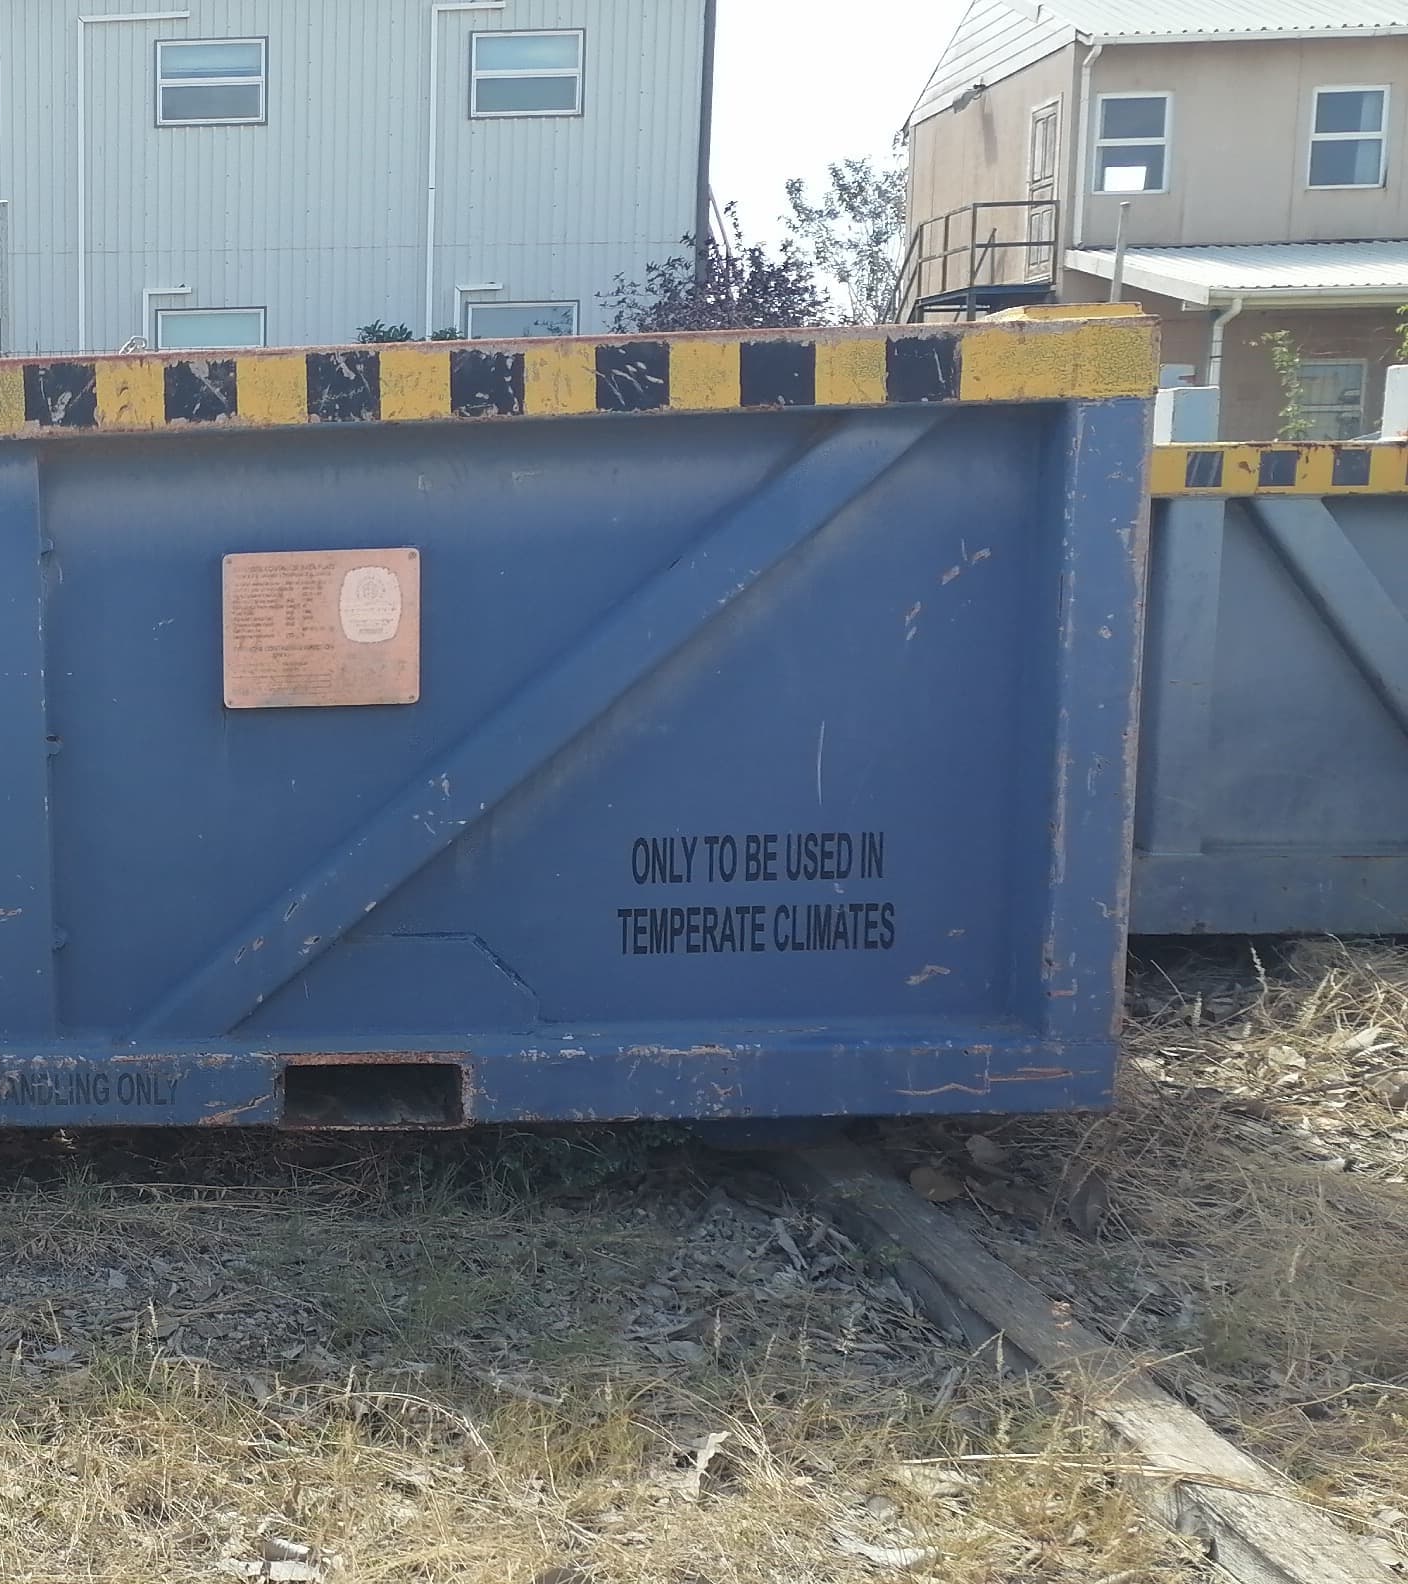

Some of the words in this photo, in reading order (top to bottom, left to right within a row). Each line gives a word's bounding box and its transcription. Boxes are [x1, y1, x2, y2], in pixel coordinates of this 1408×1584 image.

[632, 836, 697, 884] ONLY
[704, 835, 737, 882] TO
[745, 834, 777, 881] BE
[786, 832, 852, 880] USED
[861, 831, 884, 878] IN
[617, 905, 766, 955] TEMPERATE
[774, 902, 895, 951] CLIMATES
[117, 1072, 180, 1106] ONLY
